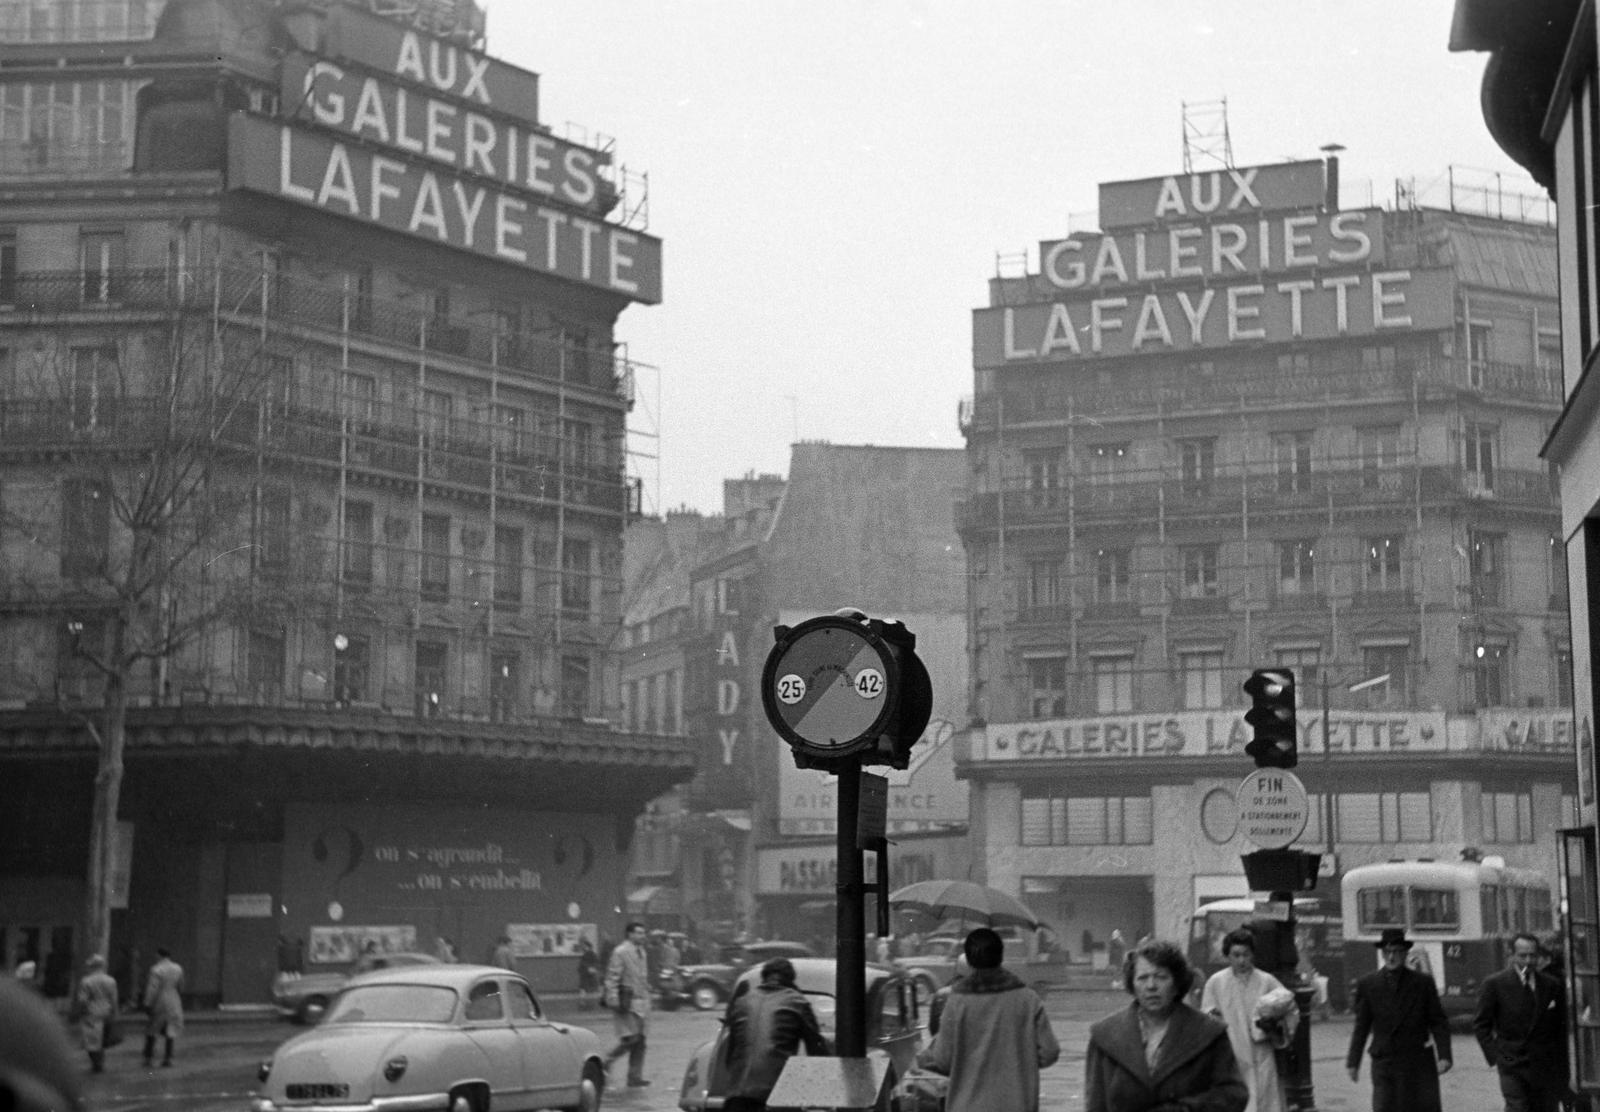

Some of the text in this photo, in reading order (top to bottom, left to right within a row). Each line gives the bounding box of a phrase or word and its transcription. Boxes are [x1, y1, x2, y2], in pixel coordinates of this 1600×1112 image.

[396, 31, 492, 105] AUX
[303, 61, 596, 204] GALERIES
[279, 126, 639, 293] LAFAYETTE
[1155, 168, 1262, 218] AUX
[1045, 212, 1372, 289] GALERIES
[1003, 270, 1412, 361] LAFAYETTE
[781, 679, 801, 699] 25
[859, 675, 879, 693] 42
[1013, 715, 1411, 757] GALERIES LAYETTE
[794, 794, 832, 809] AIR
[1258, 777, 1283, 792] FIN
[375, 846, 400, 863] on
